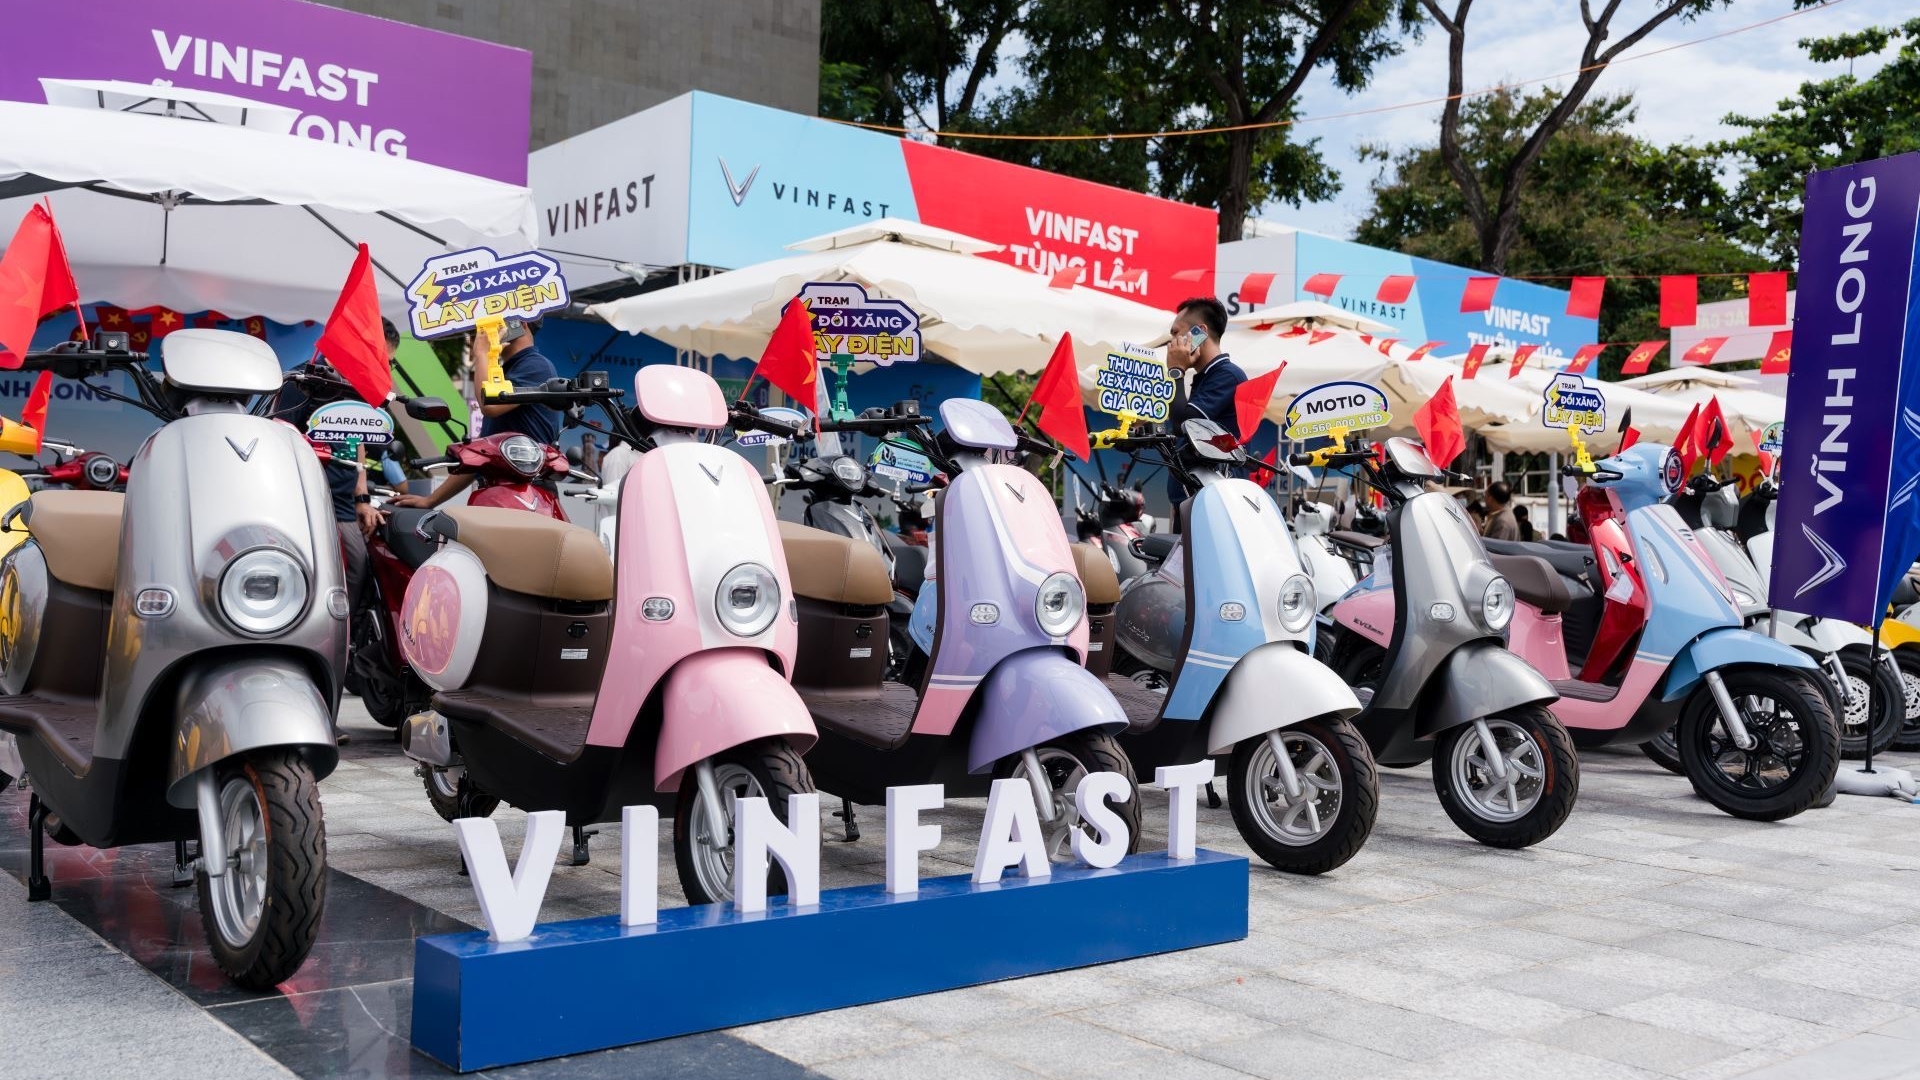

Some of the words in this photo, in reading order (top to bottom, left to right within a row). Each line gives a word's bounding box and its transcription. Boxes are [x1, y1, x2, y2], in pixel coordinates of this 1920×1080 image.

[151, 29, 379, 107] VINFAST
[296, 114, 408, 159] ONG
[547, 174, 655, 237] VINFAST
[772, 182, 889, 219] VINFAST
[1025, 206, 1139, 256] VINFAST
[442, 261, 478, 276] TRẠM
[1831, 175, 1877, 345] LONG
[446, 275, 481, 297] ĐỔI
[481, 266, 542, 289] XĂNG
[419, 297, 478, 330] LẤY
[484, 281, 560, 315] ĐIỆN
[817, 296, 849, 307] TRẠM
[1340, 296, 1406, 321] VINFAST
[818, 310, 848, 327] ĐỔI
[851, 313, 902, 328] XĂNG
[1484, 306, 1551, 337] VINFAST
[812, 328, 844, 354] ẤY
[847, 332, 914, 360] ĐIỆN
[1108, 355, 1133, 373] THU
[1133, 361, 1165, 380] MUA
[48, 382, 113, 402] ONG
[1098, 371, 1115, 387] XE
[1114, 374, 1153, 396] XĂNG
[1153, 382, 1173, 399] CŨ
[1101, 391, 1129, 411] GIÁ
[1131, 395, 1167, 419] CAO
[1306, 394, 1366, 414] MOTIO
[1575, 396, 1599, 408] XĂNG
[321, 416, 358, 425] KLARA
[360, 418, 383, 427] NEO
[1573, 409, 1602, 429] ĐIỆN
[1811, 368, 1857, 516] VĨNH
[452, 758, 1215, 943] VINFAST
